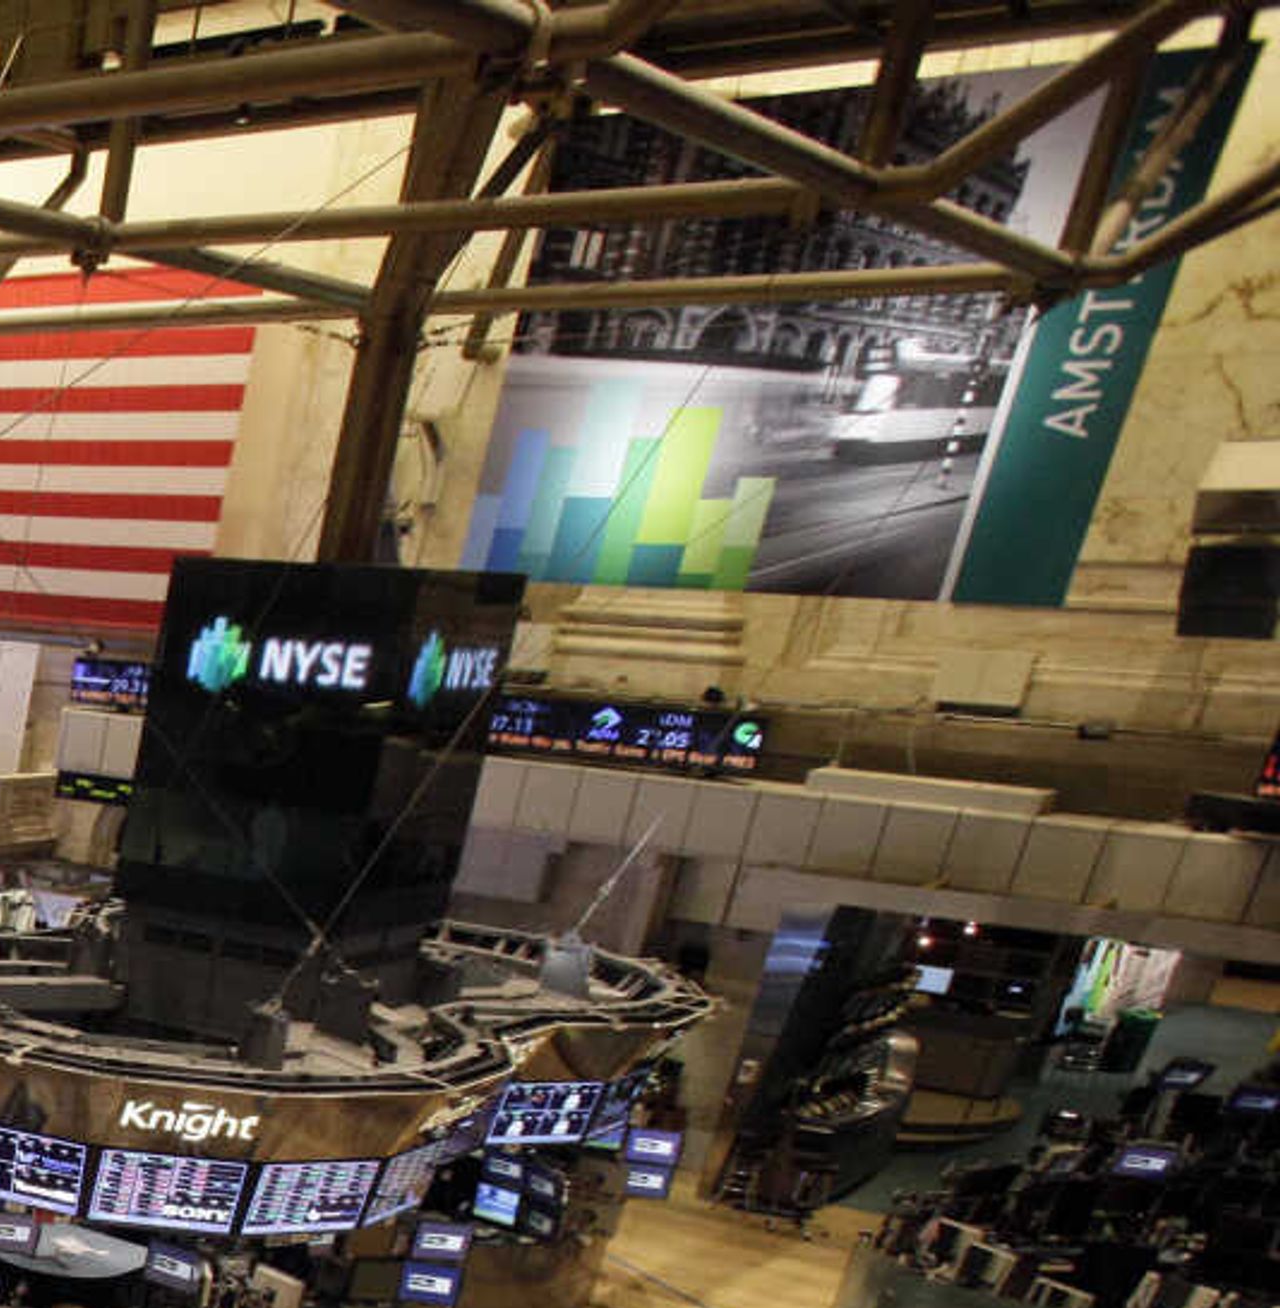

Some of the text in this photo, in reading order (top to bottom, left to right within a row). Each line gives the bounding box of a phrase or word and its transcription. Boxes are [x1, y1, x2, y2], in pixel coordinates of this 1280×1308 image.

[1043, 85, 1186, 438] AMSTRDM
[260, 636, 371, 689] NYSE
[445, 648, 499, 690] NYSE
[120, 1101, 260, 1141] Knight
